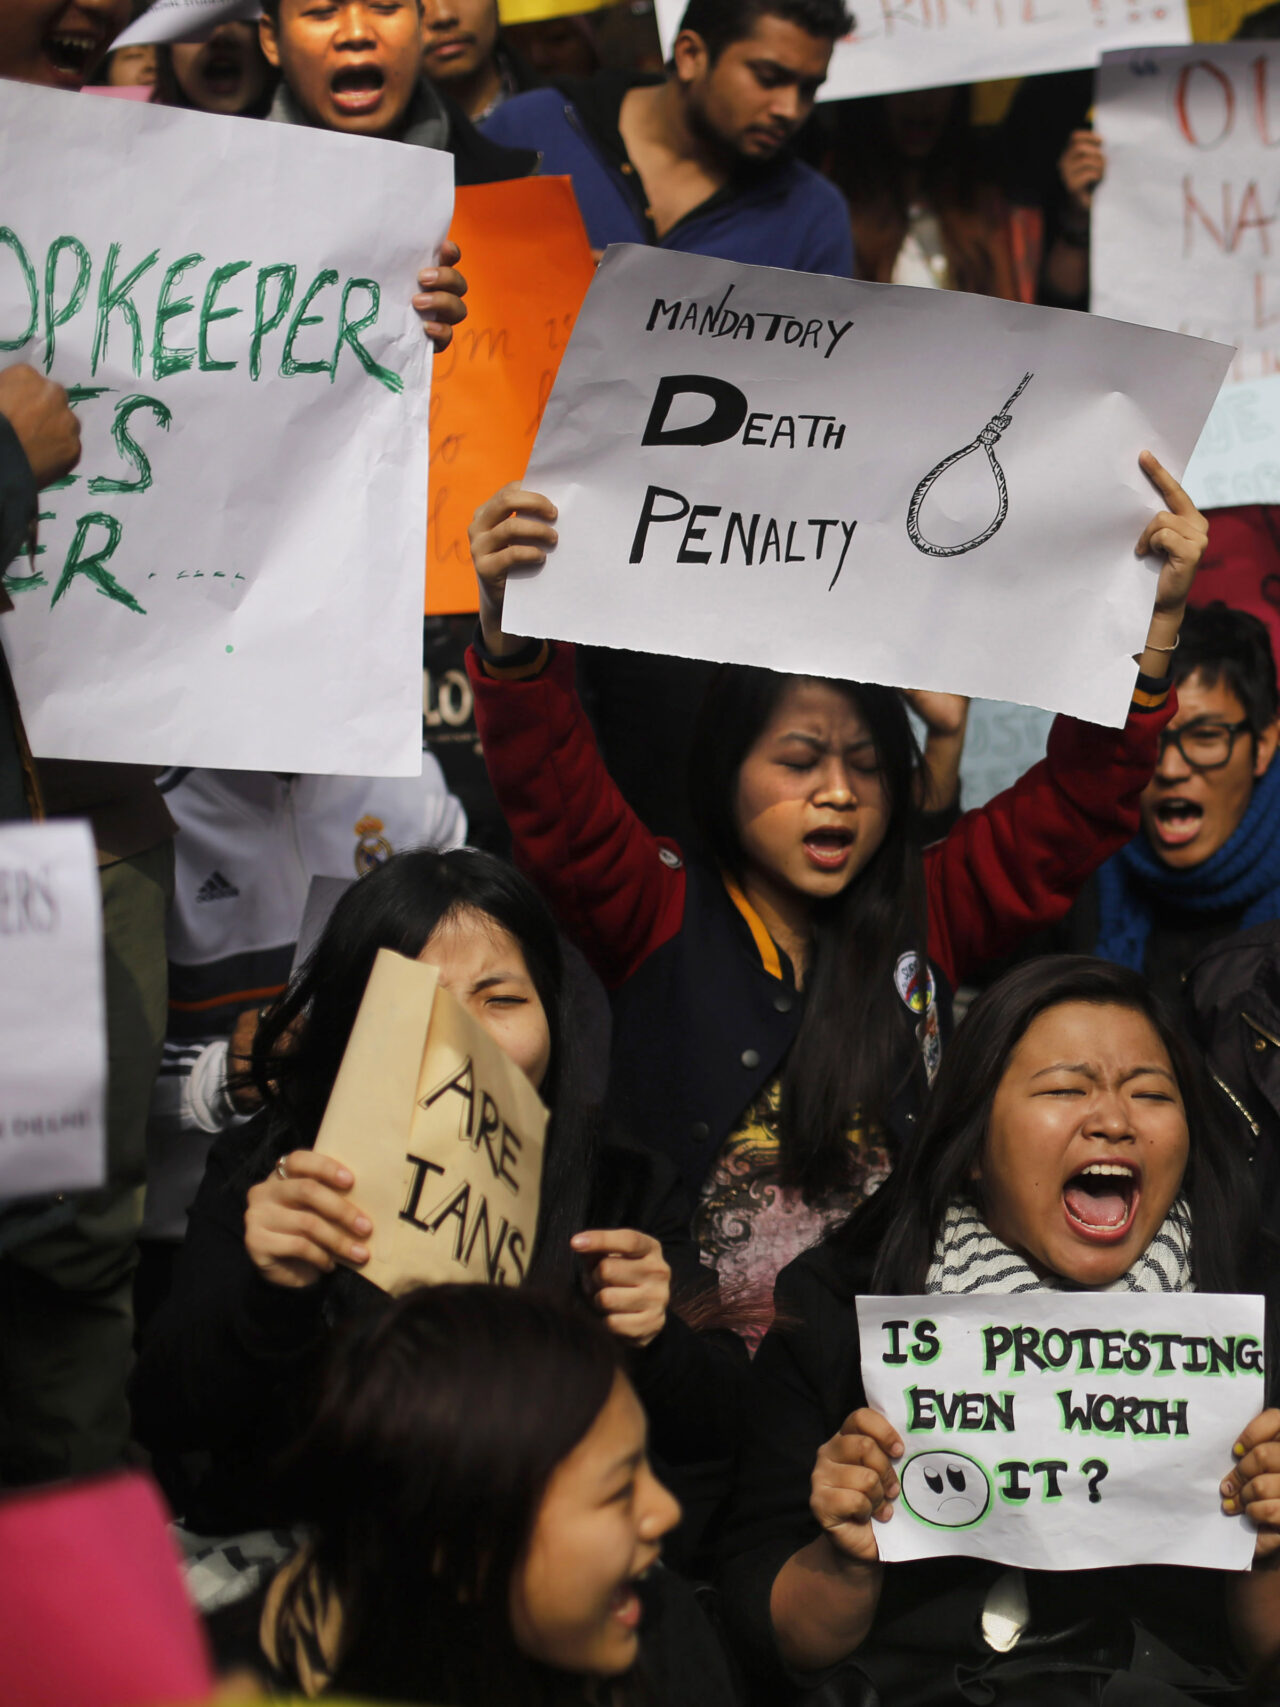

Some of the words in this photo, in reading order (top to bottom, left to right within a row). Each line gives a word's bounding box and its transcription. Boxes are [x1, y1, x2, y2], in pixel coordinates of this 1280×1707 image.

[646, 284, 854, 358] MANDATORY
[640, 374, 847, 450] DEATH
[628, 485, 858, 592] PENALTY
[418, 1055, 523, 1196] ARE
[881, 1320, 941, 1366] IS
[981, 1324, 1264, 1377] PROTESTING
[904, 1384, 1016, 1433] EVEN
[1056, 1389, 1189, 1440] WORTH
